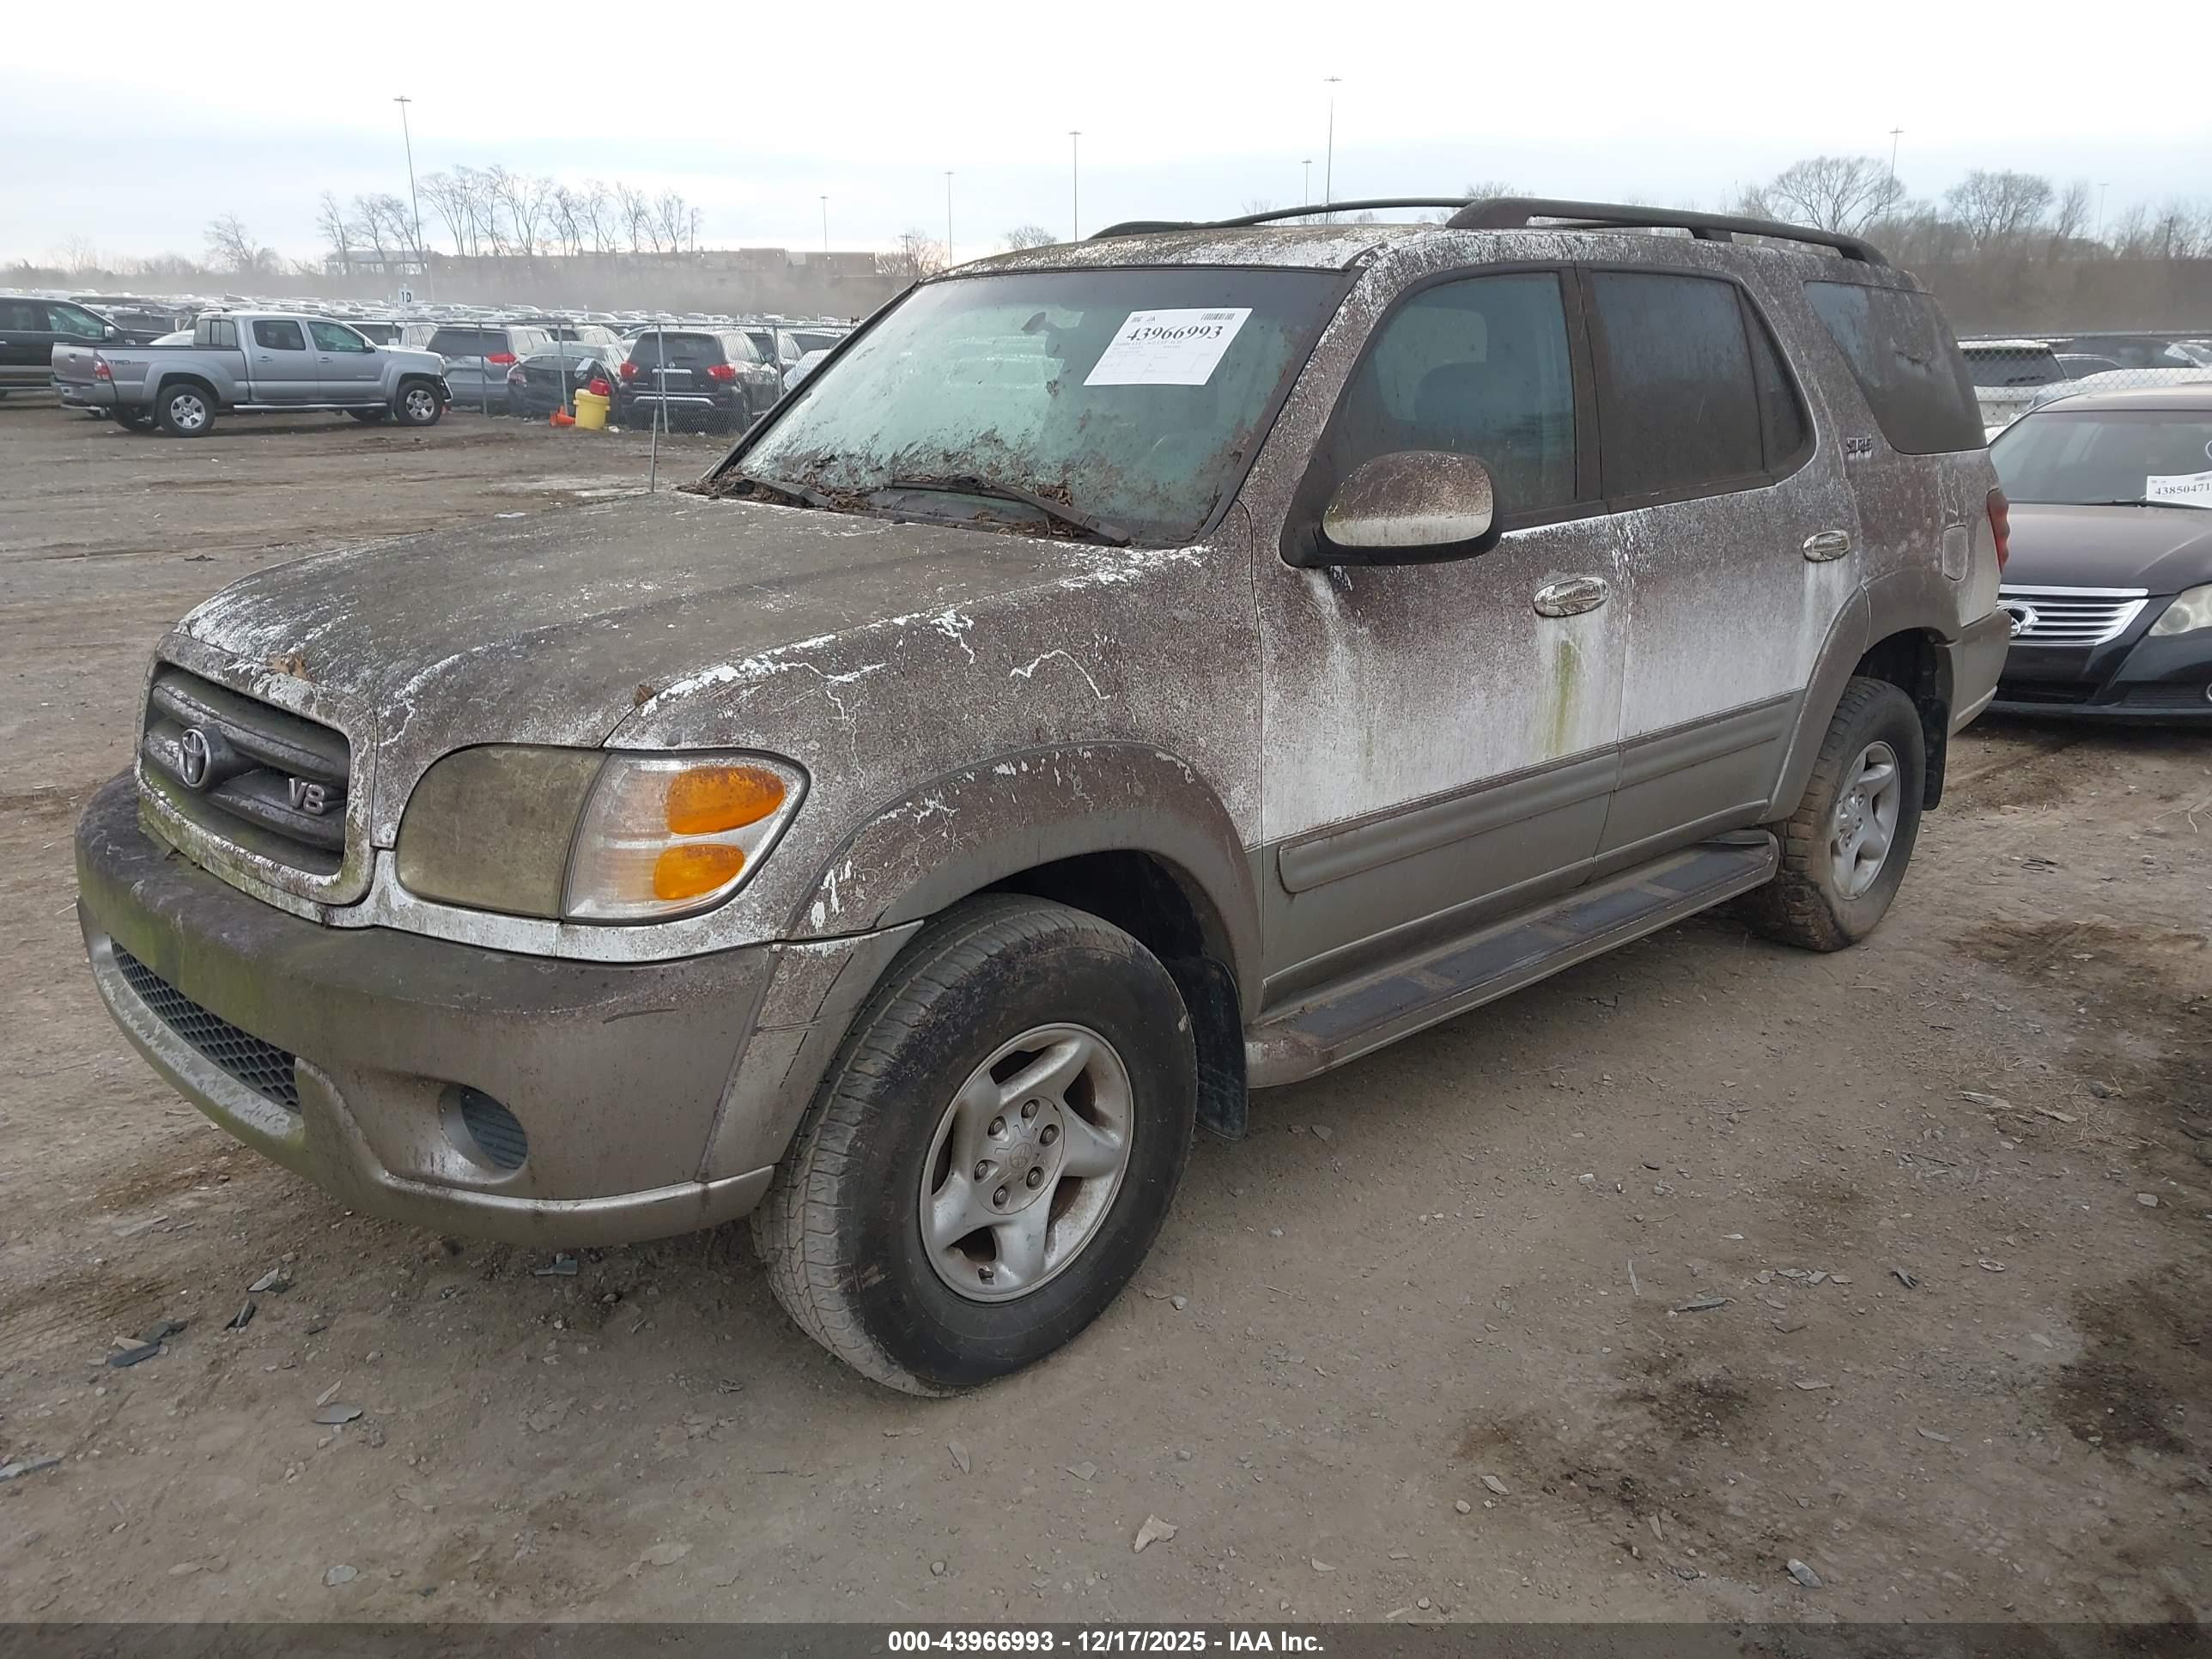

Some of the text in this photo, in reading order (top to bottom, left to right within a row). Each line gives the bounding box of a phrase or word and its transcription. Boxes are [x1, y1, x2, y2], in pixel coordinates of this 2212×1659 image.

[1126, 325, 1224, 341] 43966993
[2155, 483, 2210, 495] 43850471
[289, 777, 325, 816] V8
